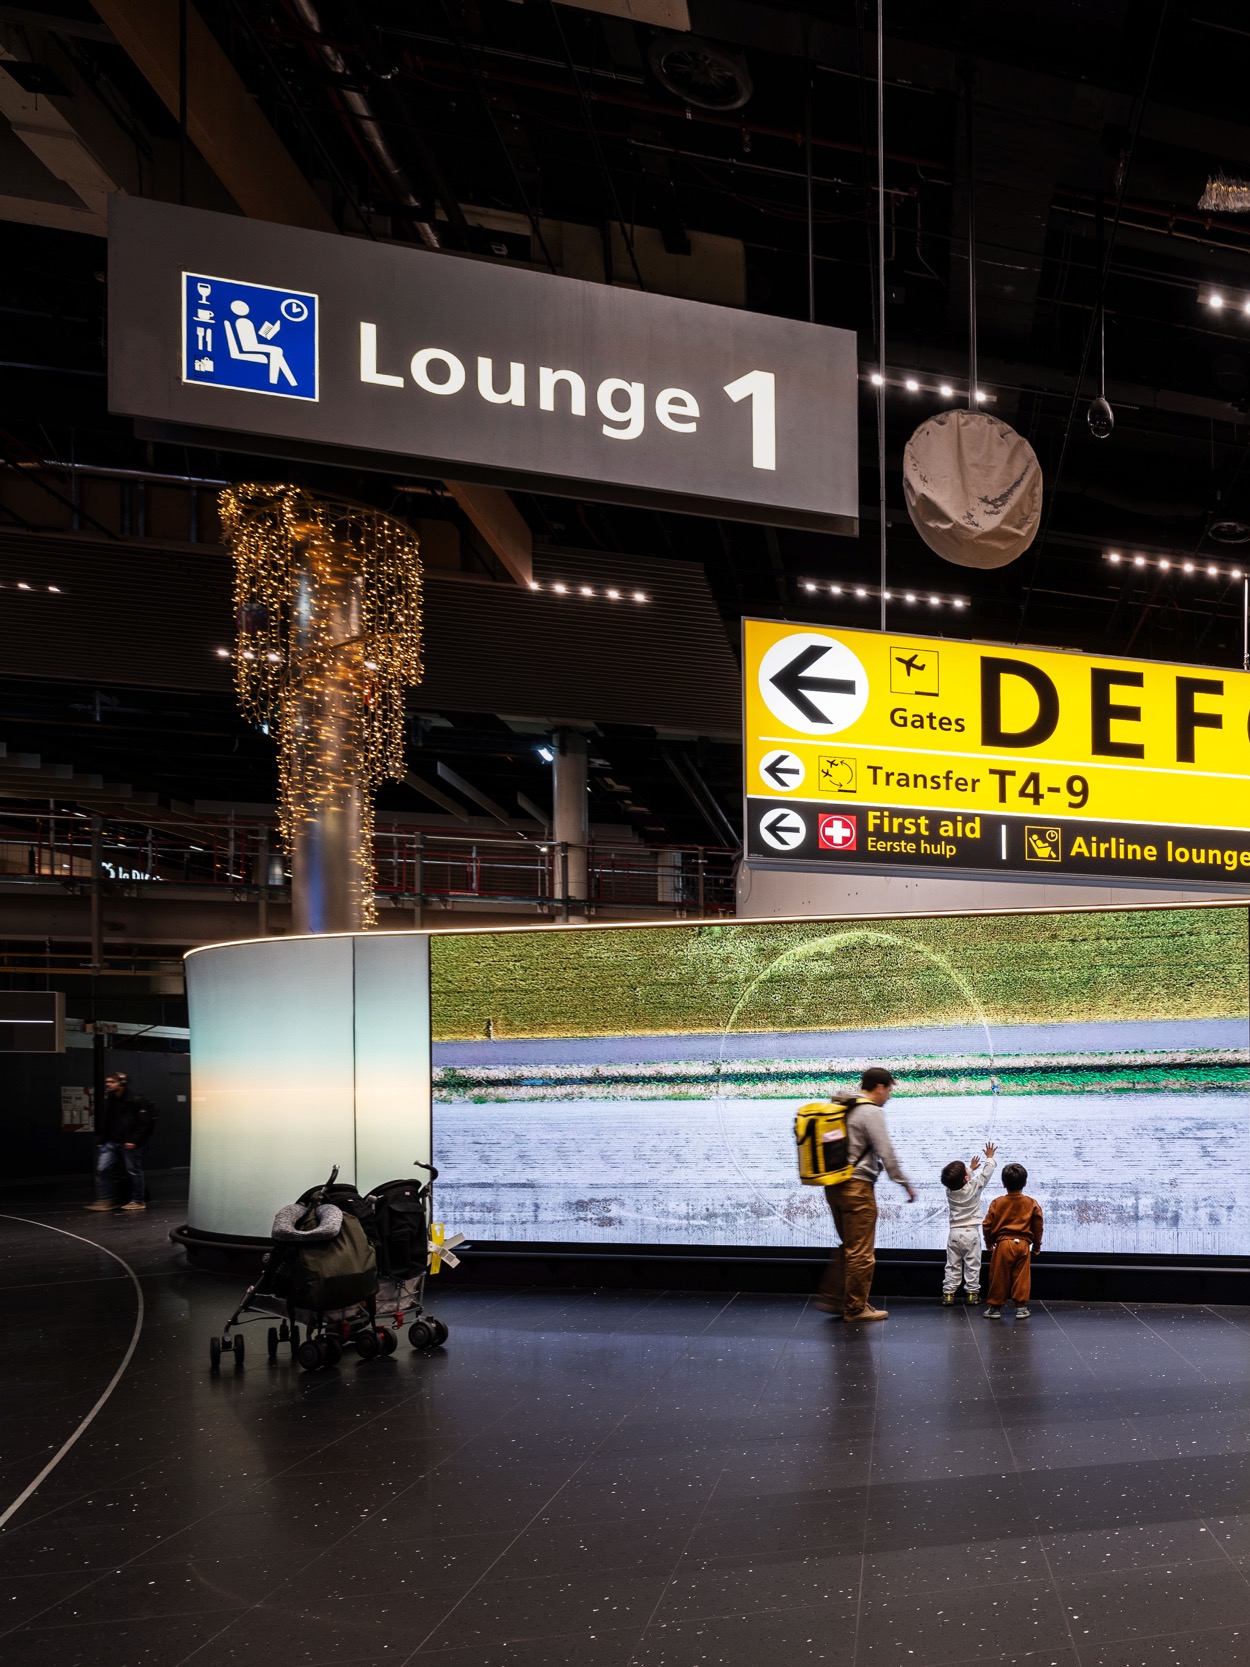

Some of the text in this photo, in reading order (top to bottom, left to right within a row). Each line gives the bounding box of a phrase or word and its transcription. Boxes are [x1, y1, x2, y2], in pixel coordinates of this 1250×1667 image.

[359, 322, 777, 472] Lounge 1
[889, 707, 966, 733] Gates
[867, 765, 1090, 809] Transfer T4-9
[867, 811, 981, 839] First aid
[867, 837, 957, 859] Eerste hulp
[1070, 834, 1157, 862] Airline
